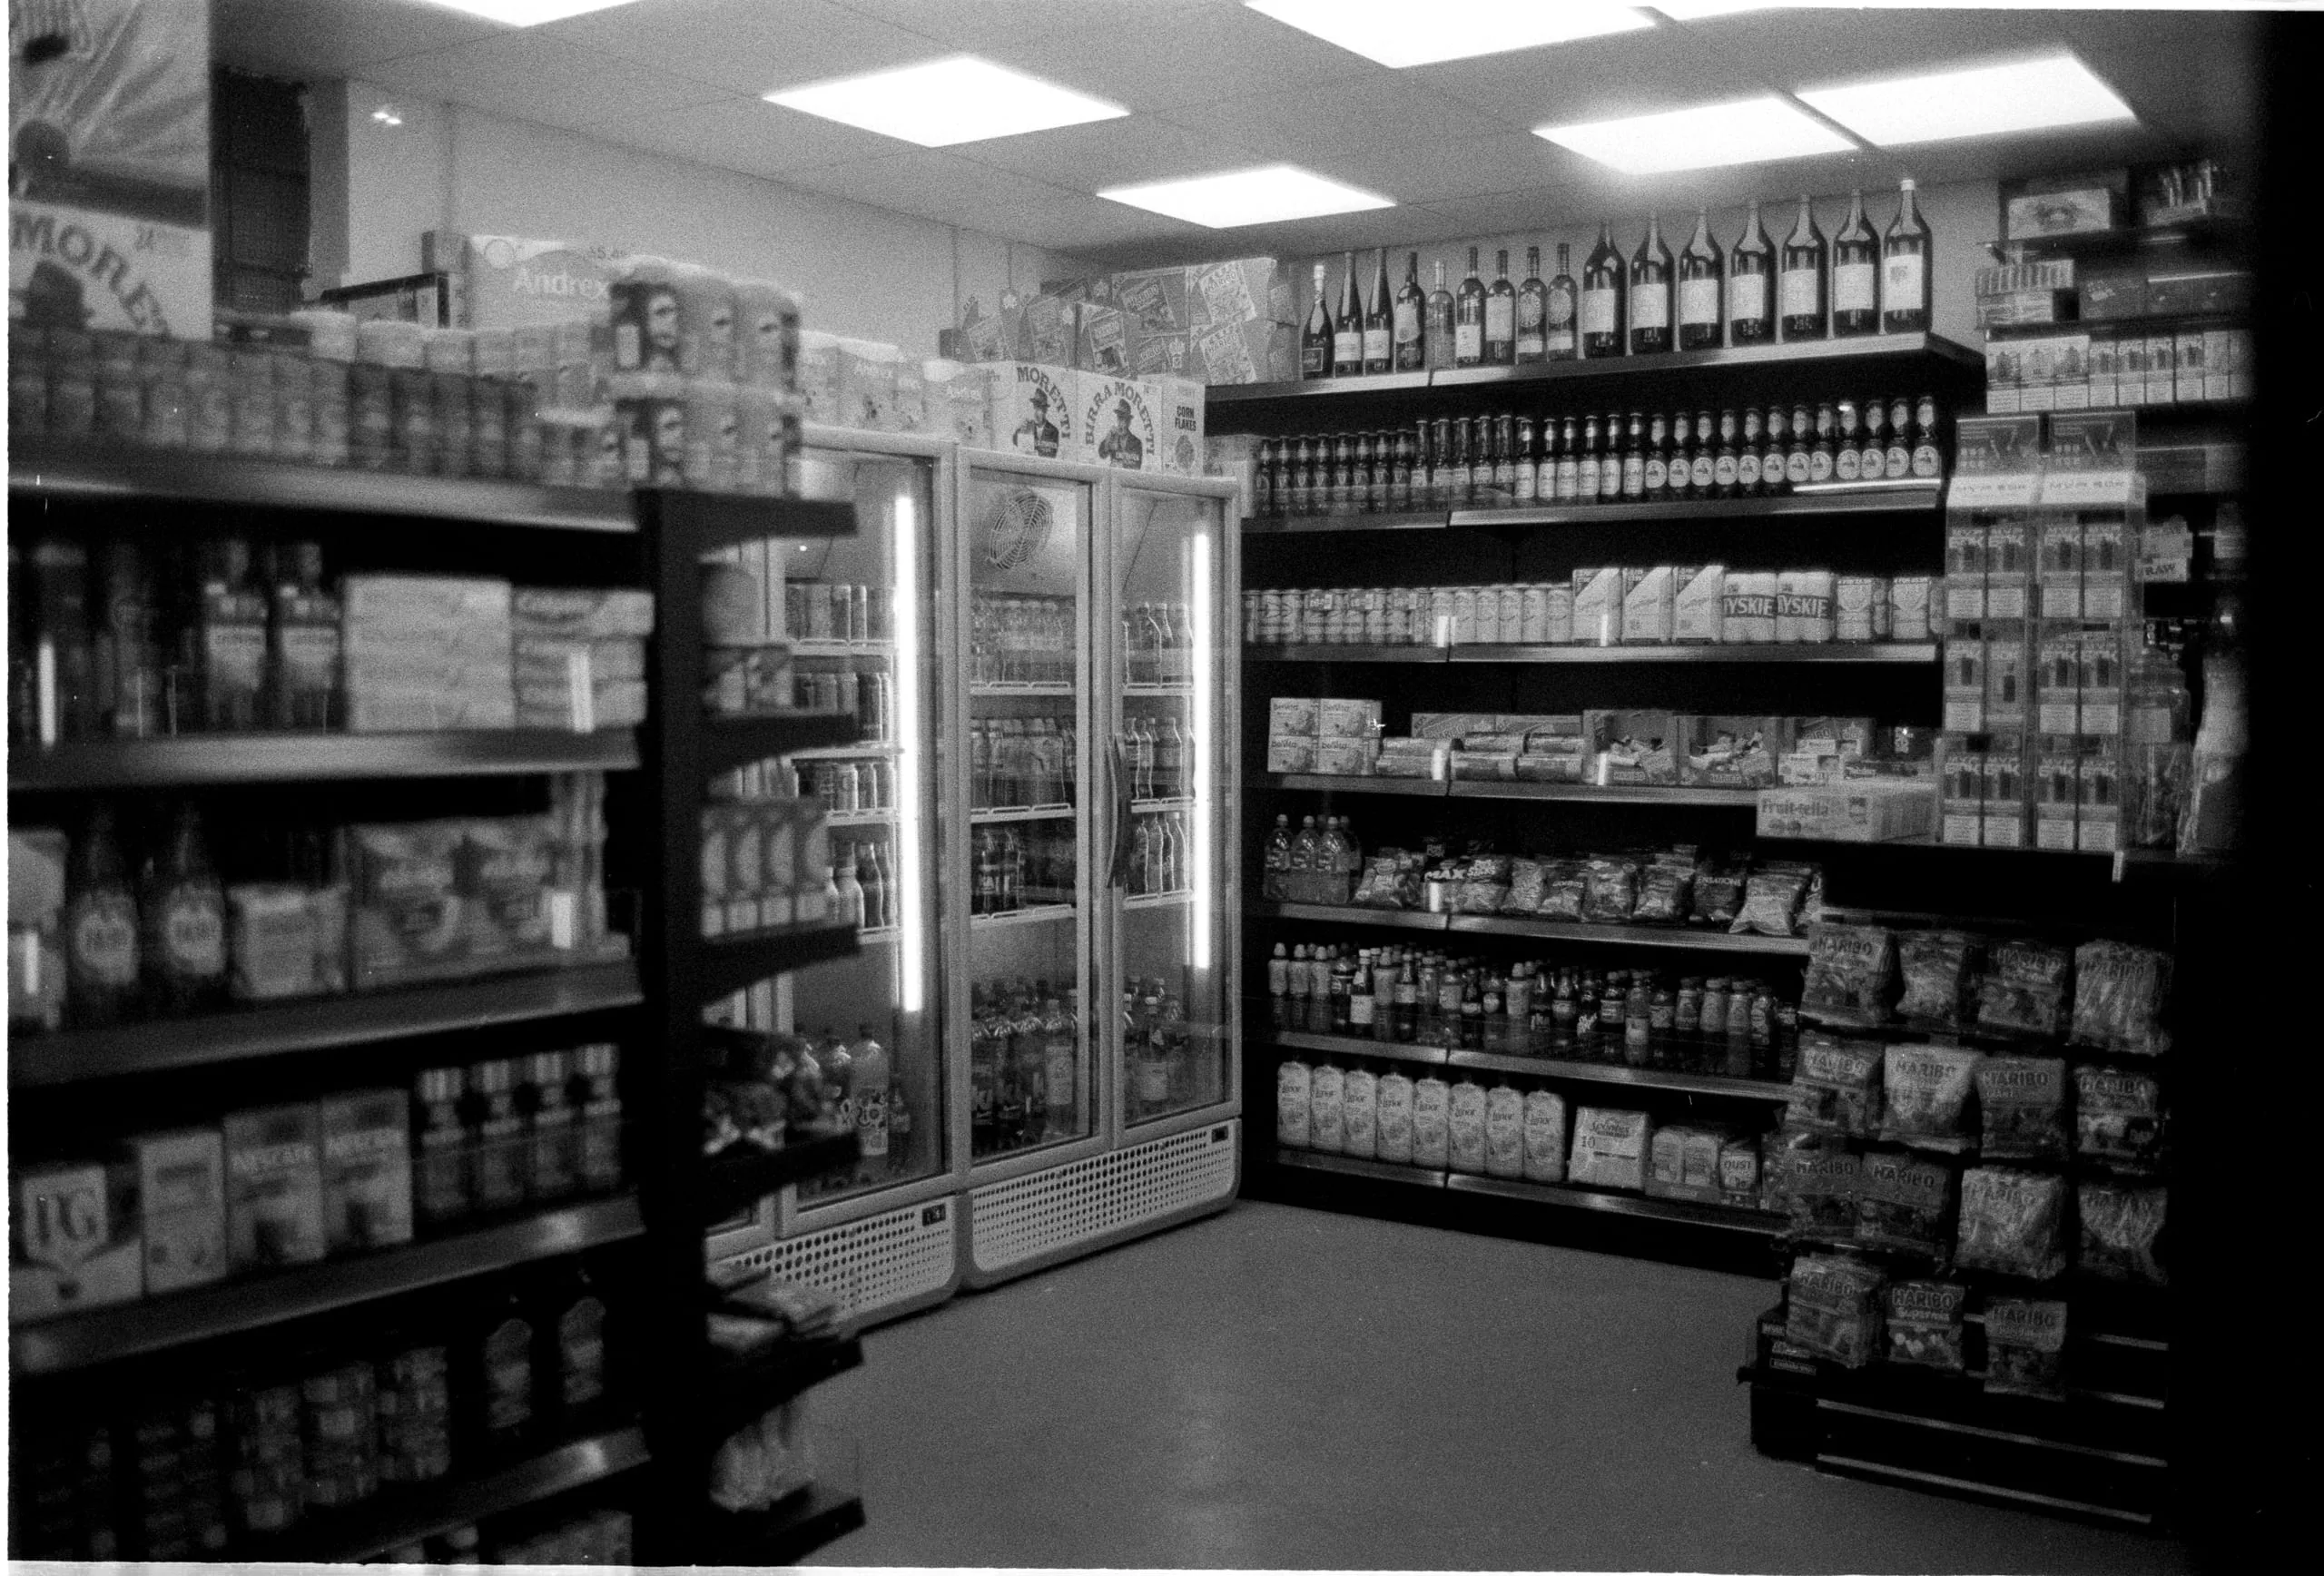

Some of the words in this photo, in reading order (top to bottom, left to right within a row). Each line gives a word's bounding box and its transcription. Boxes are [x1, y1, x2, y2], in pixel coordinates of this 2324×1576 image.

[514, 270, 609, 300] Andrex
[1017, 366, 1071, 439] MORETTI
[1177, 405, 1196, 419] CORN
[1085, 384, 1113, 446] BIRRA
[1114, 381, 1156, 456] MORETTI
[1174, 418, 1197, 432] FLAKES
[2145, 564, 2176, 576] RAW
[1723, 597, 1776, 616] TYSKIE
[1777, 595, 1829, 617] TYSKIE
[1761, 799, 1828, 817] Fruit-tella
[1424, 868, 1468, 880] MAX
[1697, 876, 1742, 887] ENSATIONS
[1818, 936, 1874, 956] HARIBO
[1896, 1059, 1956, 1079] HARIBO
[1983, 1070, 2049, 1087] HARIBO
[1581, 1136, 1596, 1148] 10
[1796, 1161, 1854, 1176] HARIBO
[1874, 1165, 1935, 1188] HARIBO
[1800, 1271, 1856, 1298] HARIBO
[1892, 1286, 1955, 1309] HARIBO
[1994, 1307, 2056, 1327] HARIBO
